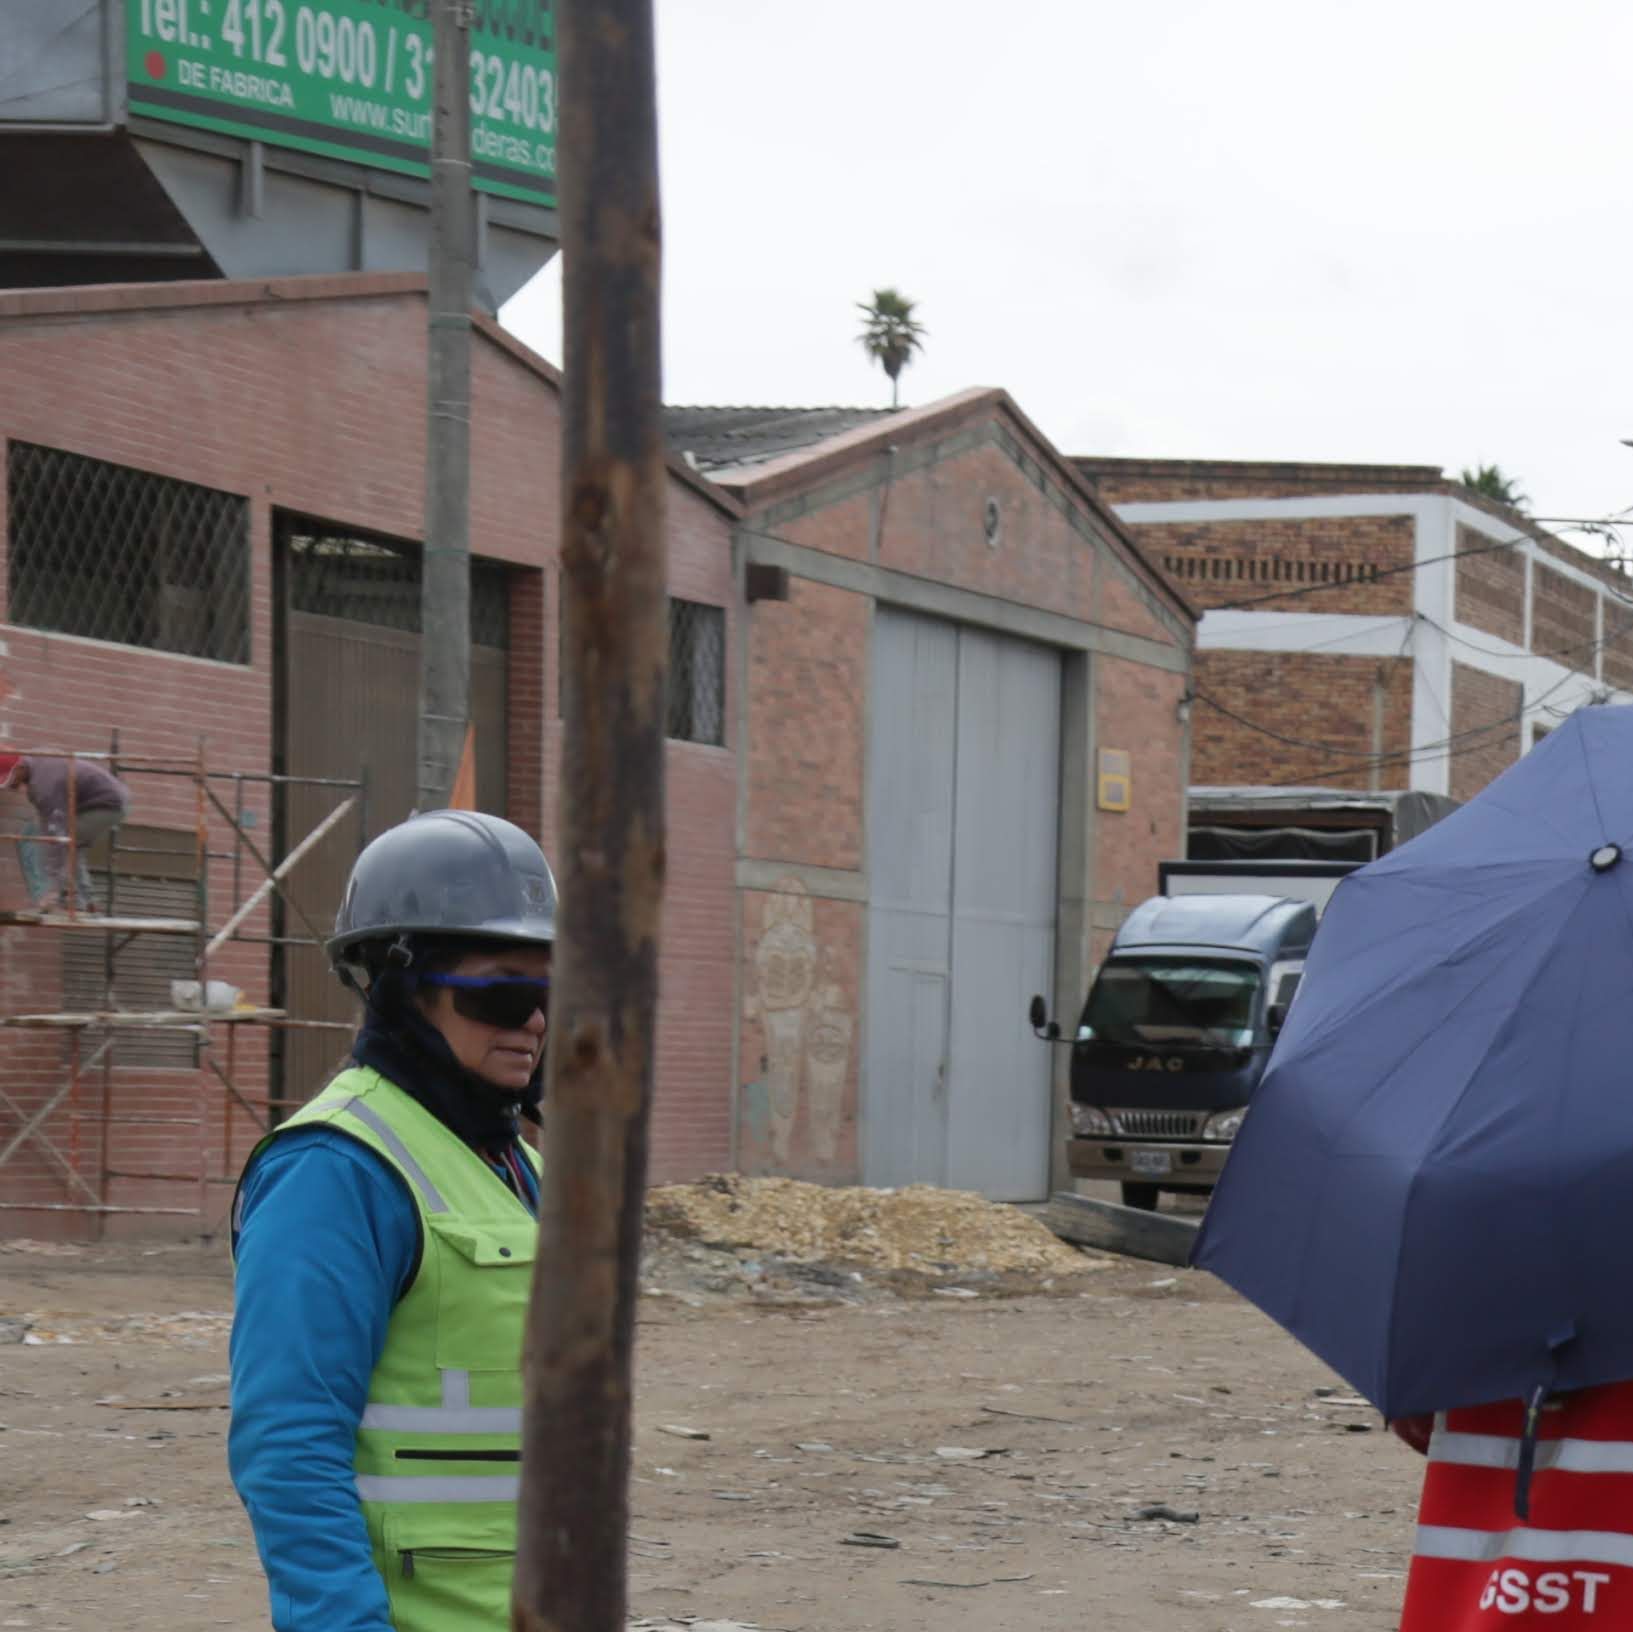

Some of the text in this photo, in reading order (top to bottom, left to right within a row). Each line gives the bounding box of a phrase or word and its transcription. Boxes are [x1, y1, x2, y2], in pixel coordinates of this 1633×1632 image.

[178, 58, 296, 109] DE FABRICA
[221, 0, 287, 67] 412
[296, 6, 376, 88] 0900
[468, 50, 560, 134] 32403
